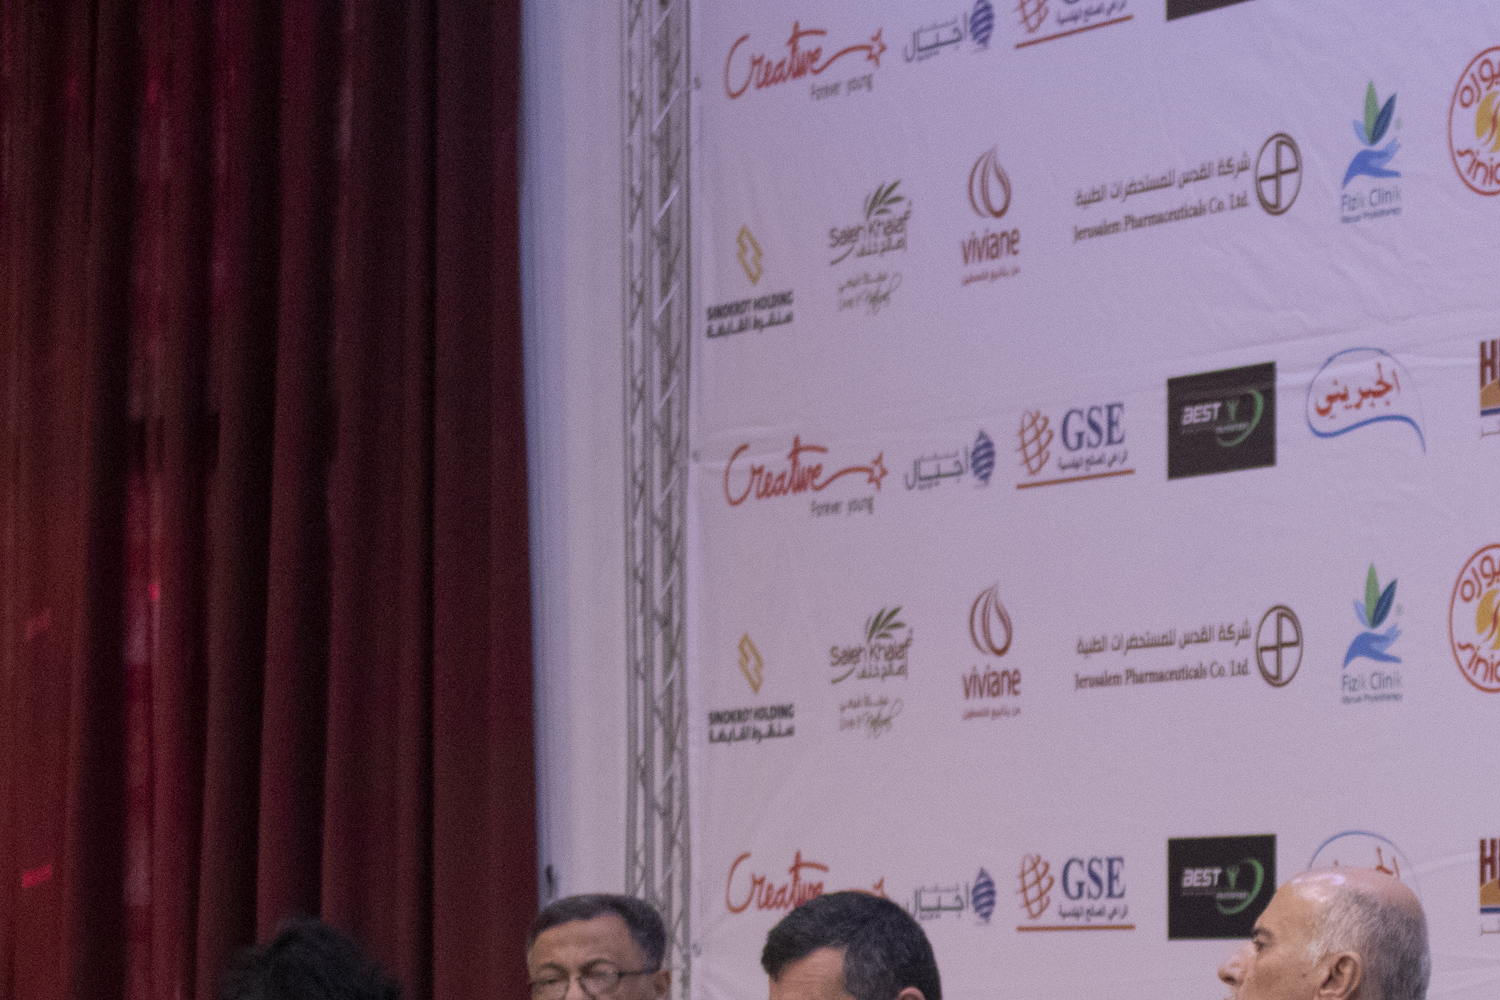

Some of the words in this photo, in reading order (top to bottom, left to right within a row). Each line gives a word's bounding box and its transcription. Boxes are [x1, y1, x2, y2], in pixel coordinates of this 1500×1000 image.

[724, 20, 845, 99] Creative
[1062, 402, 1126, 453] GSE
[1181, 401, 1223, 427] BEST
[724, 435, 845, 507] Creative
[1062, 856, 1126, 901] GSE
[1181, 866, 1223, 888] BEST
